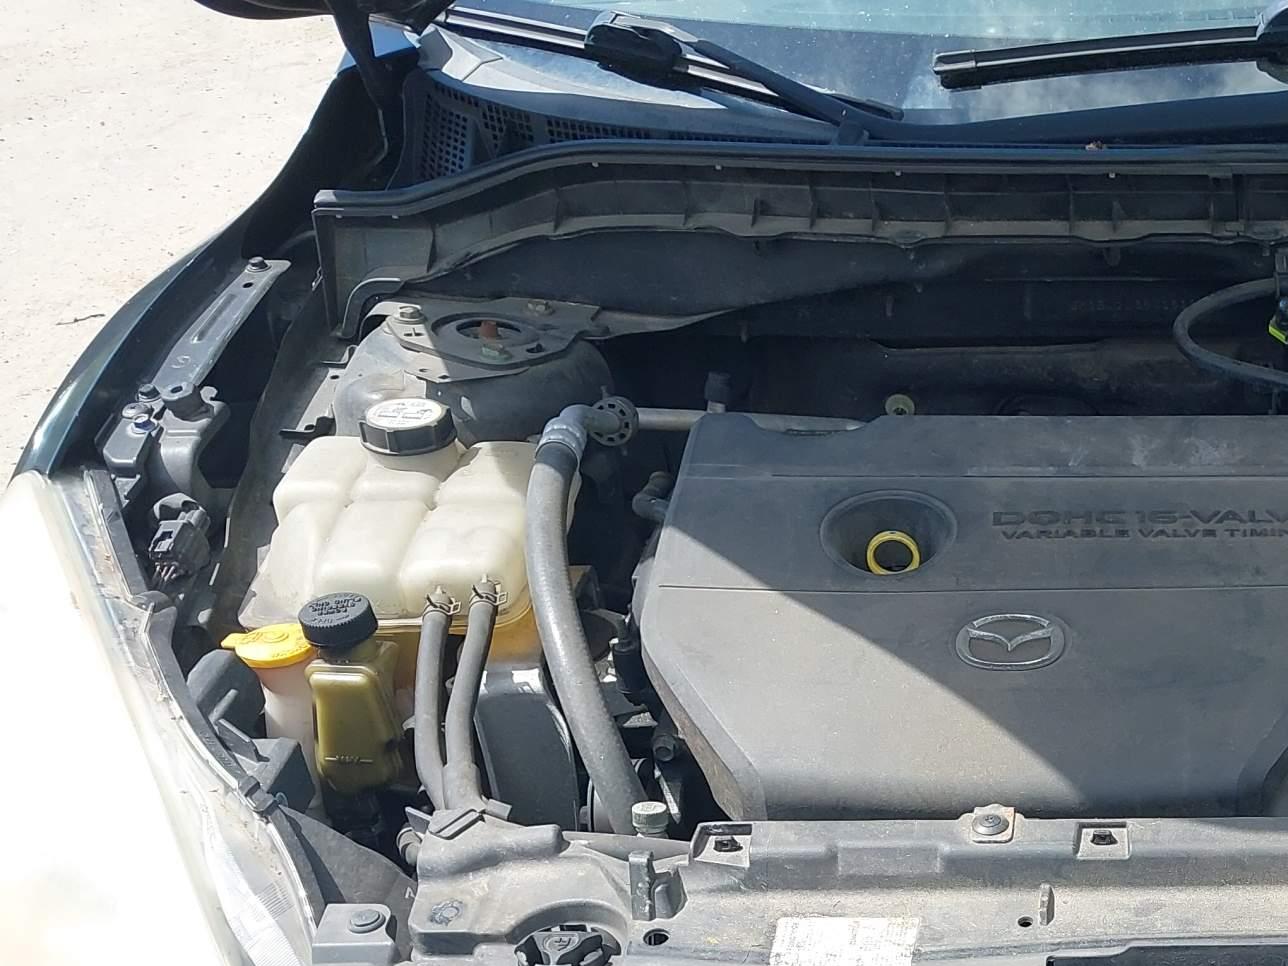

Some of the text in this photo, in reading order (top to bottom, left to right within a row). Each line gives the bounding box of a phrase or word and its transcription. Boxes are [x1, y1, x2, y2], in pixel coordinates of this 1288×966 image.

[992, 510, 1127, 526] DOHC
[1001, 529, 1131, 539] VARIABLE
[1138, 528, 1217, 538] VALVE
